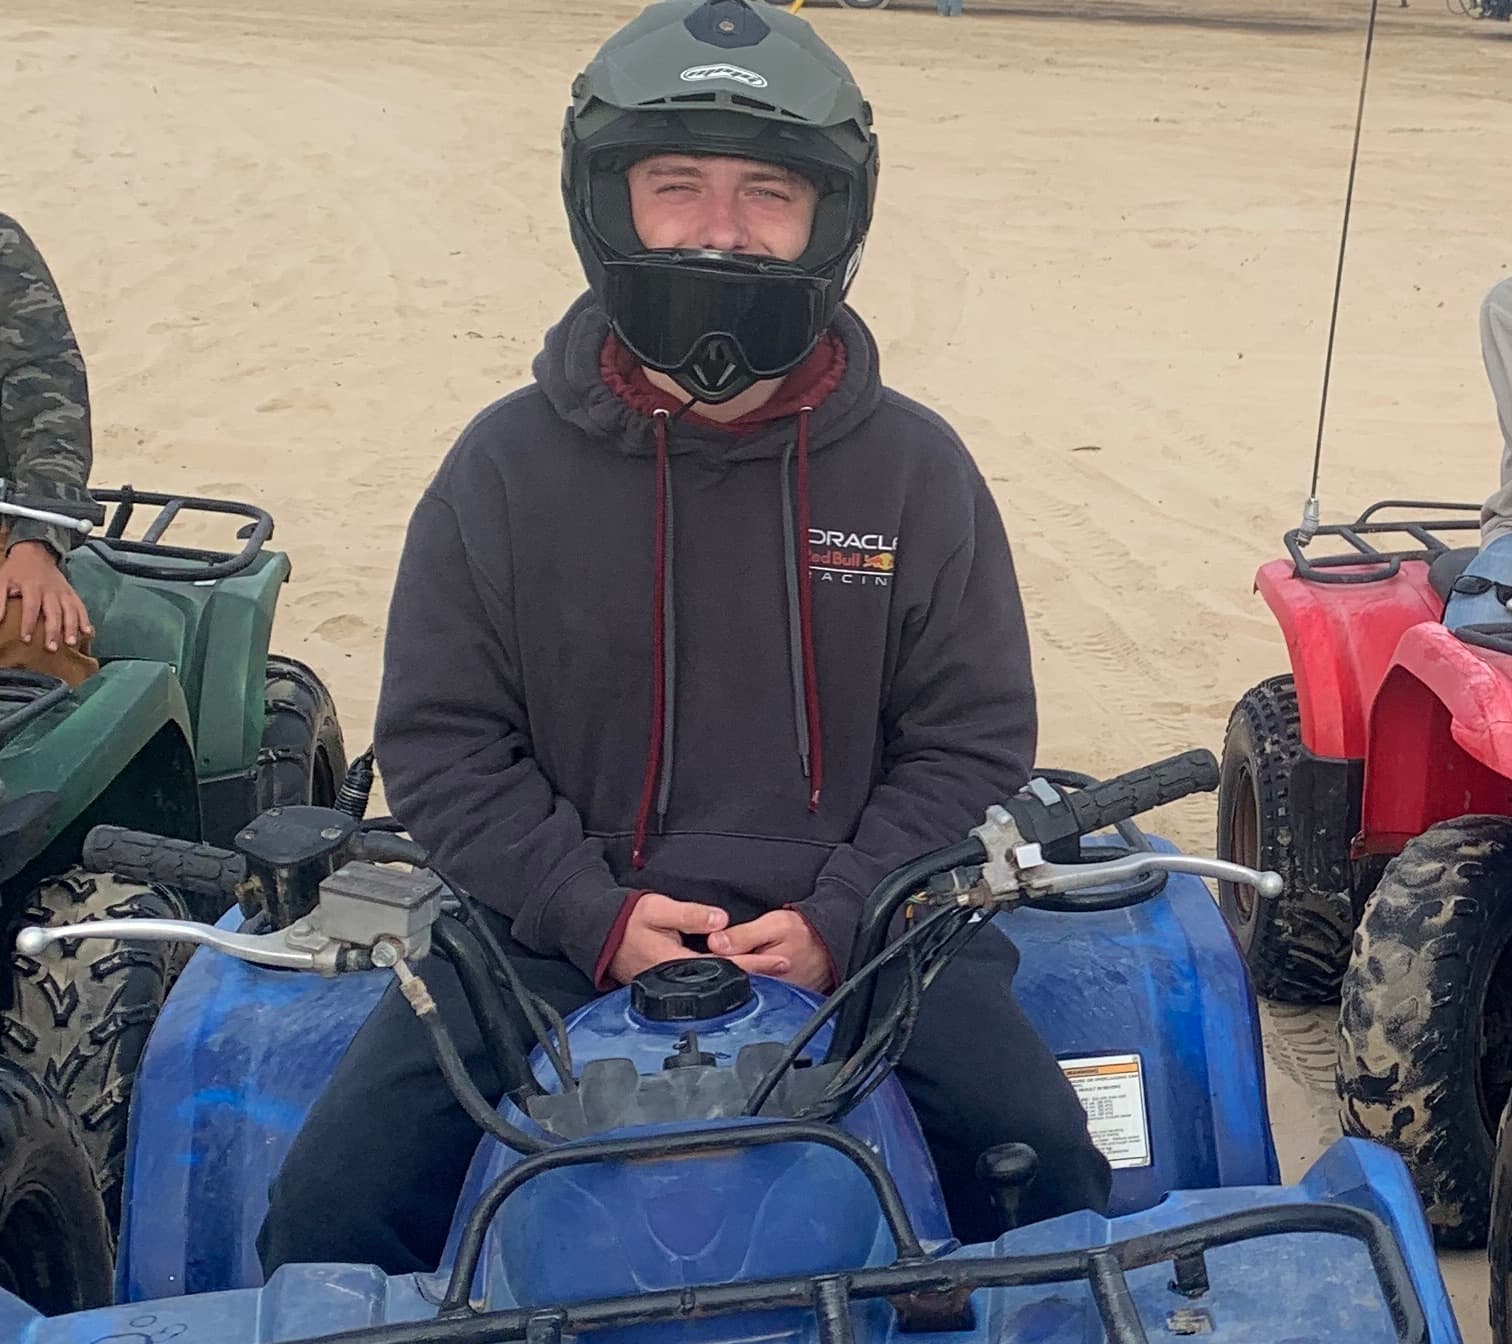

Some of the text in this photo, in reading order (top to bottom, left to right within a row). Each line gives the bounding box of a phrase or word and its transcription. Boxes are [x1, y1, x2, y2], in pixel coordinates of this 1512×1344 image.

[808, 550, 861, 567] ed Bull
[808, 571, 888, 586] ACIN
